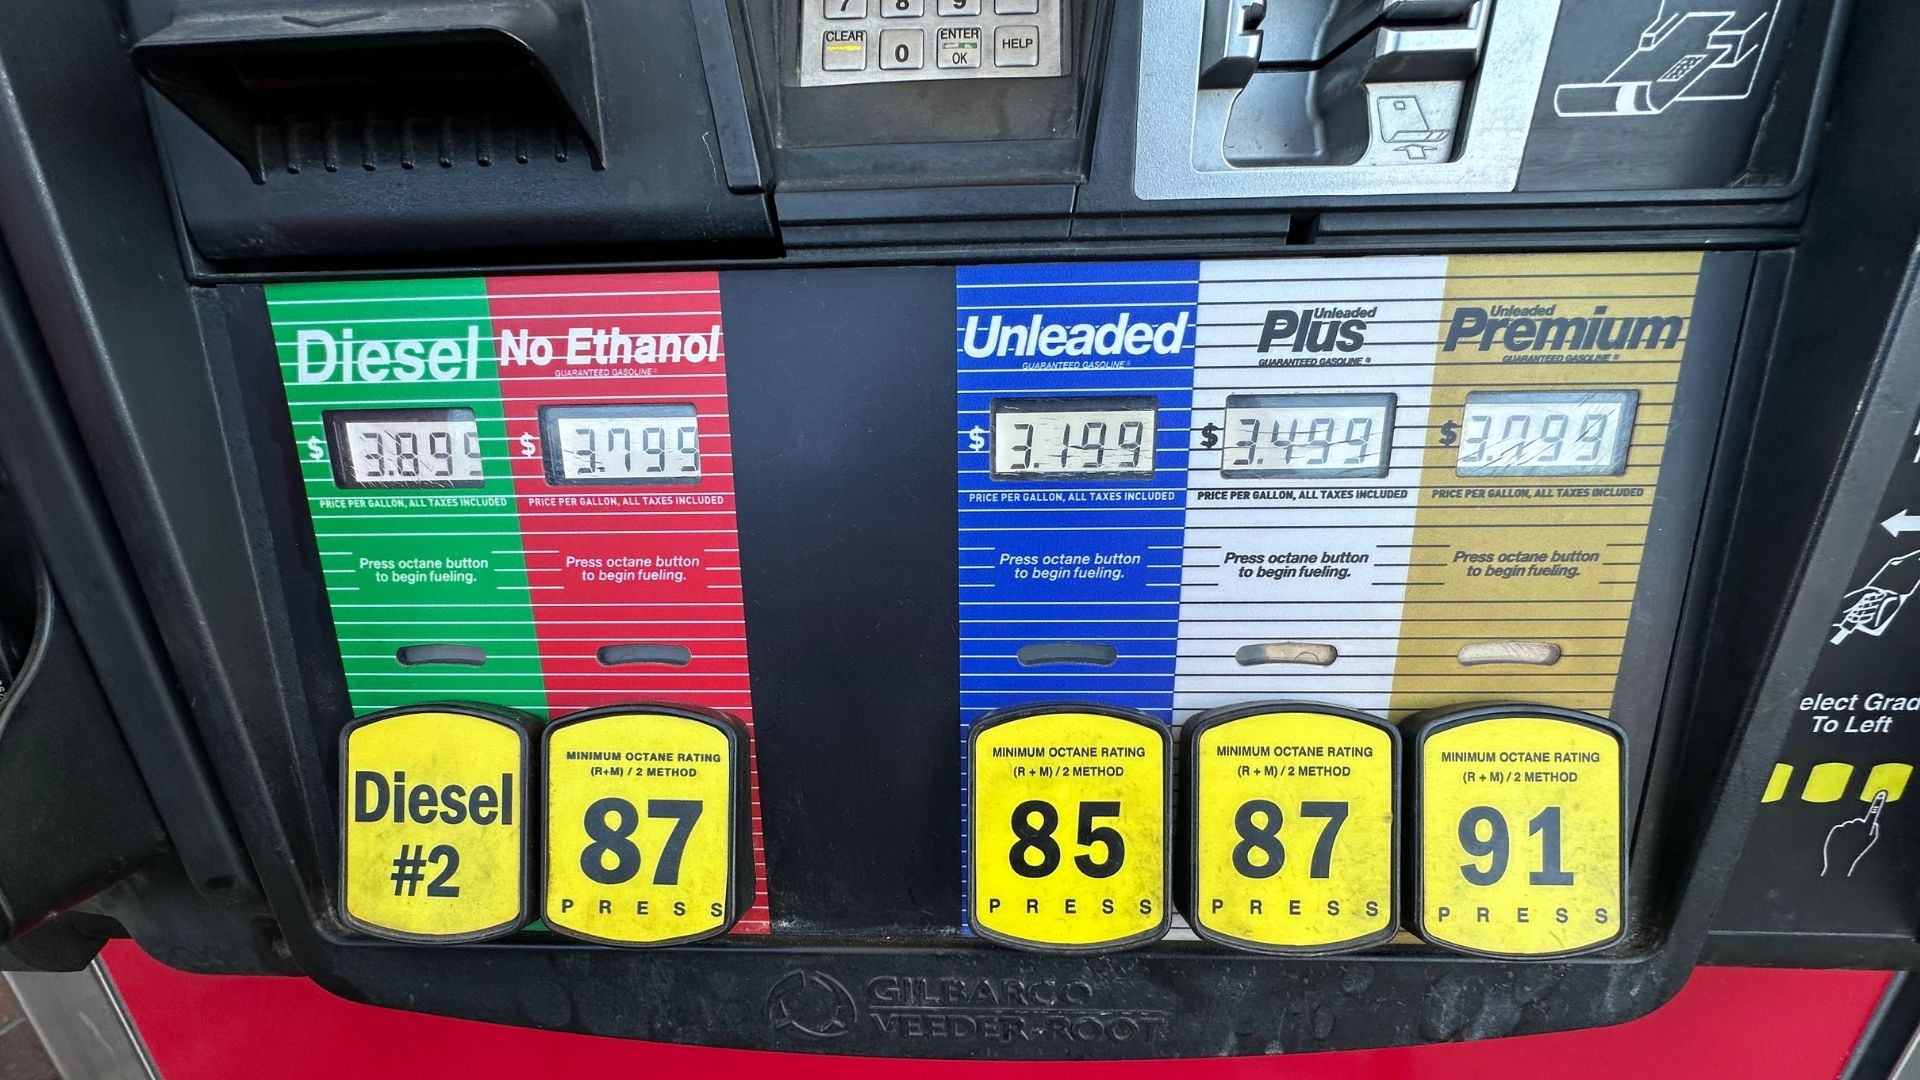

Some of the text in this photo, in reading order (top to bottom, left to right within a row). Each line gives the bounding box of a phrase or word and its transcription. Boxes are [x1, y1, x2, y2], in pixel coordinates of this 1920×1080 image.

[826, 31, 863, 42] CLEAR
[940, 28, 979, 40] ENTER
[1002, 38, 1033, 49] HELP
[895, 44, 909, 63] 0
[952, 52, 967, 64] OK
[1314, 307, 1378, 319] Unleaded
[1490, 304, 1556, 316] Unleaded
[963, 312, 1190, 358] Unleaded
[1257, 310, 1367, 353] Plus
[1442, 306, 1684, 352] Premium
[500, 325, 720, 366] No Ethanol
[297, 325, 479, 382] Diesel
[1503, 355, 1564, 363] GUARANTEED
[1022, 362, 1080, 370] GUARANTEED
[1258, 358, 1318, 367] GUARANTEED
[554, 368, 609, 377] GUARANTEED
[1200, 418, 1373, 465] $ 3.499
[1439, 414, 1608, 462] $ 3.799
[308, 436, 324, 460] $
[520, 432, 536, 457] $
[968, 422, 1143, 469] $ 3.199
[970, 492, 1175, 502] PRICE PER GALLON, ALL TAXES INCLUDED
[1198, 490, 1408, 501] PRICE PER GALLON, ALL TAXES INCLUDED
[1432, 488, 1644, 499] PRICE PER GALLON, ALL TAXES INCLUDED
[320, 498, 507, 509] PRICE PER GALLON, ALL TAXES INCLUDED
[528, 496, 724, 506] PRICE PER GALLON, ALL TAXES INCLUDED
[566, 556, 699, 567] Press octane button
[1000, 553, 1141, 565] Press octane button
[1224, 552, 1369, 564] Press octane button
[1453, 550, 1599, 562] Press octane button
[360, 557, 488, 569] Press octane button
[376, 571, 477, 584] to begin fueling.
[582, 569, 686, 583] to begin fueling.
[1014, 567, 1124, 581] to begin fueling.
[1238, 566, 1351, 580] to begin fueling.
[1467, 564, 1581, 579] to begin fueling.
[1800, 692, 1920, 711] elect Grad
[1812, 716, 1893, 733] To Left
[566, 751, 721, 762] MINIMUM OCTANE RATING
[992, 747, 1145, 758] MINIMUM OCTANE RATING
[1217, 746, 1373, 758] MINIMUM OCTANE RATING
[1442, 752, 1600, 763] MINIMUM OCTANE RATING
[590, 767, 623, 778] (R+M)
[636, 768, 643, 777] 2
[646, 768, 697, 778] METHOD
[1063, 767, 1070, 777] 2
[1073, 767, 1124, 777] METHOD
[1288, 767, 1295, 776] 2
[1299, 766, 1351, 776] METHOD
[1514, 773, 1521, 782] 2
[1525, 772, 1577, 782] METHOD
[355, 771, 513, 826] Diesel
[580, 797, 704, 885] 87
[1010, 800, 1125, 878] 85
[1232, 800, 1348, 878] 87
[1458, 806, 1574, 886] 91
[391, 844, 460, 898] #2
[867, 976, 1093, 1005] GILBARCO
[870, 1013, 1170, 1041] VEEDER-ROOT
